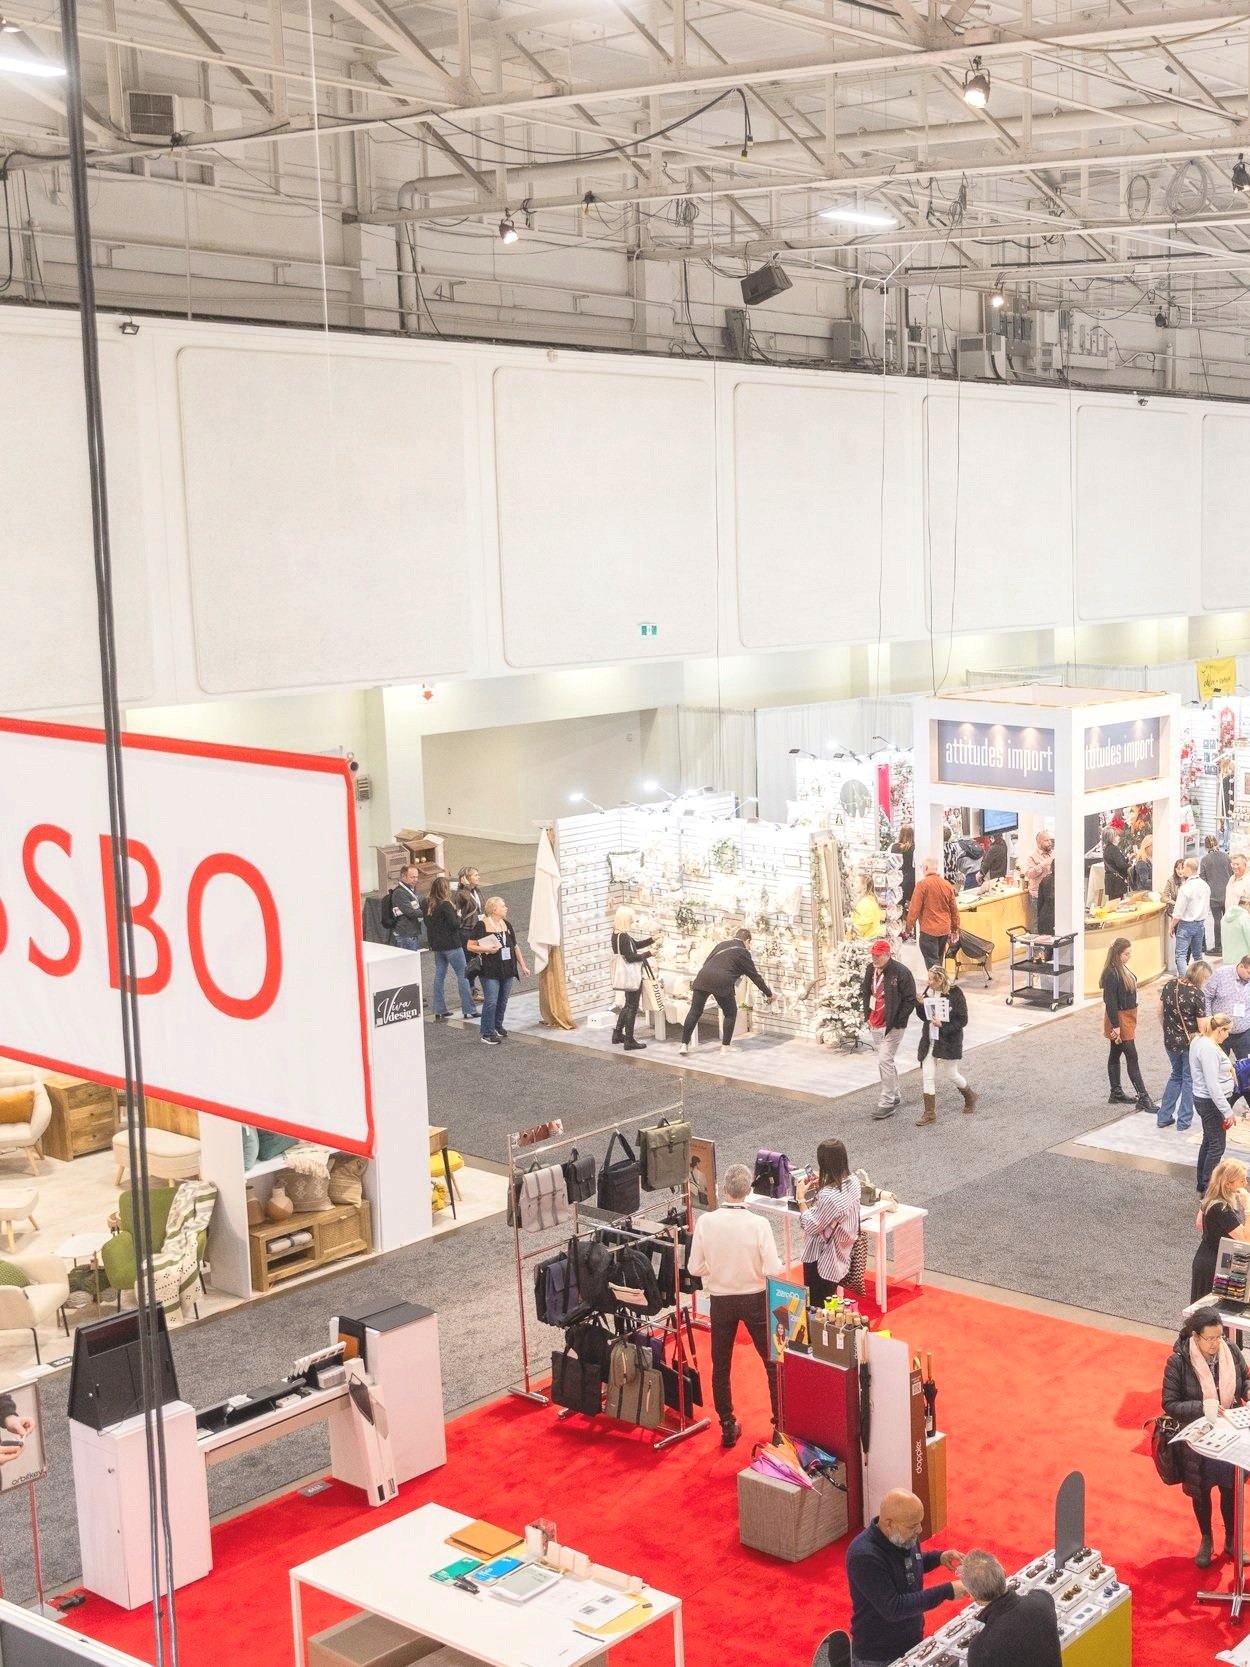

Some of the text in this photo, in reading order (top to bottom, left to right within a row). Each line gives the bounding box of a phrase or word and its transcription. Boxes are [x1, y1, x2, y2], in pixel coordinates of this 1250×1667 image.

[946, 737, 1053, 778] attitudes import
[1085, 733, 1155, 770] ttitudes import
[0, 823, 283, 1021] SBO
[377, 986, 412, 1024] Viva
[389, 1008, 418, 1022] design
